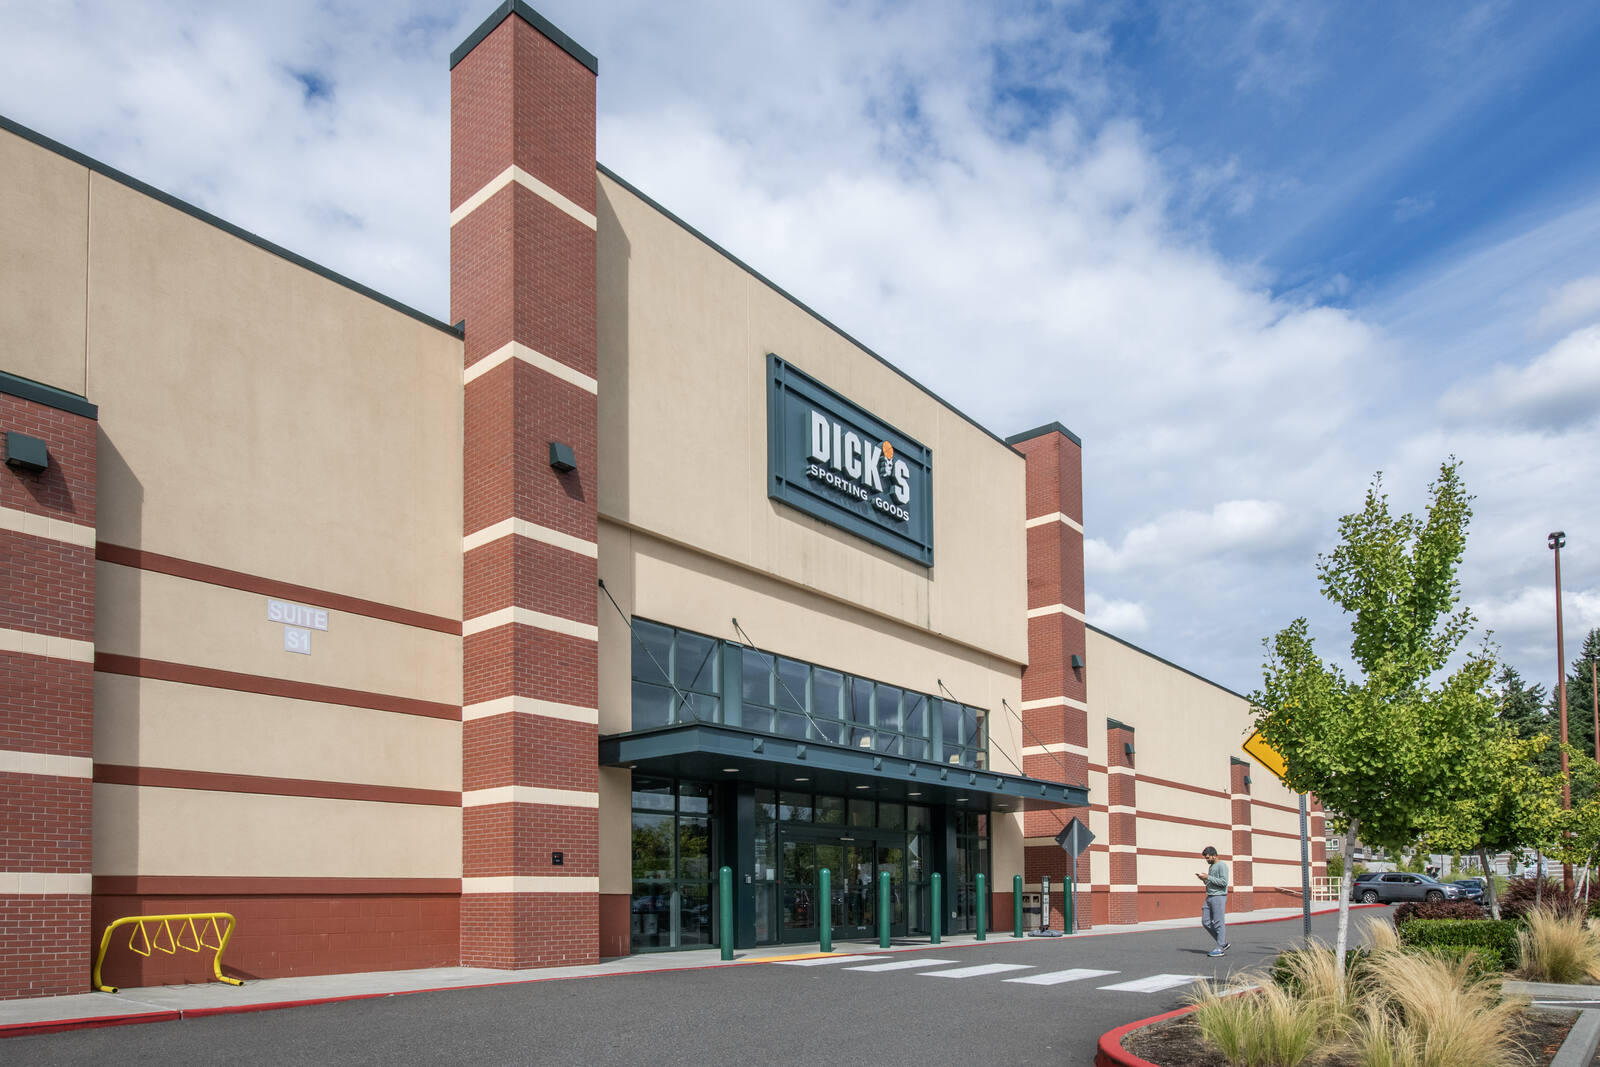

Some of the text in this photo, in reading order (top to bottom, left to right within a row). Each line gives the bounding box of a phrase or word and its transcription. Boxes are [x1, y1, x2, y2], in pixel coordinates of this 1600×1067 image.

[811, 410, 910, 504] DICK'S
[810, 464, 910, 521] SPORTING GOODS
[270, 602, 328, 628] SUITE
